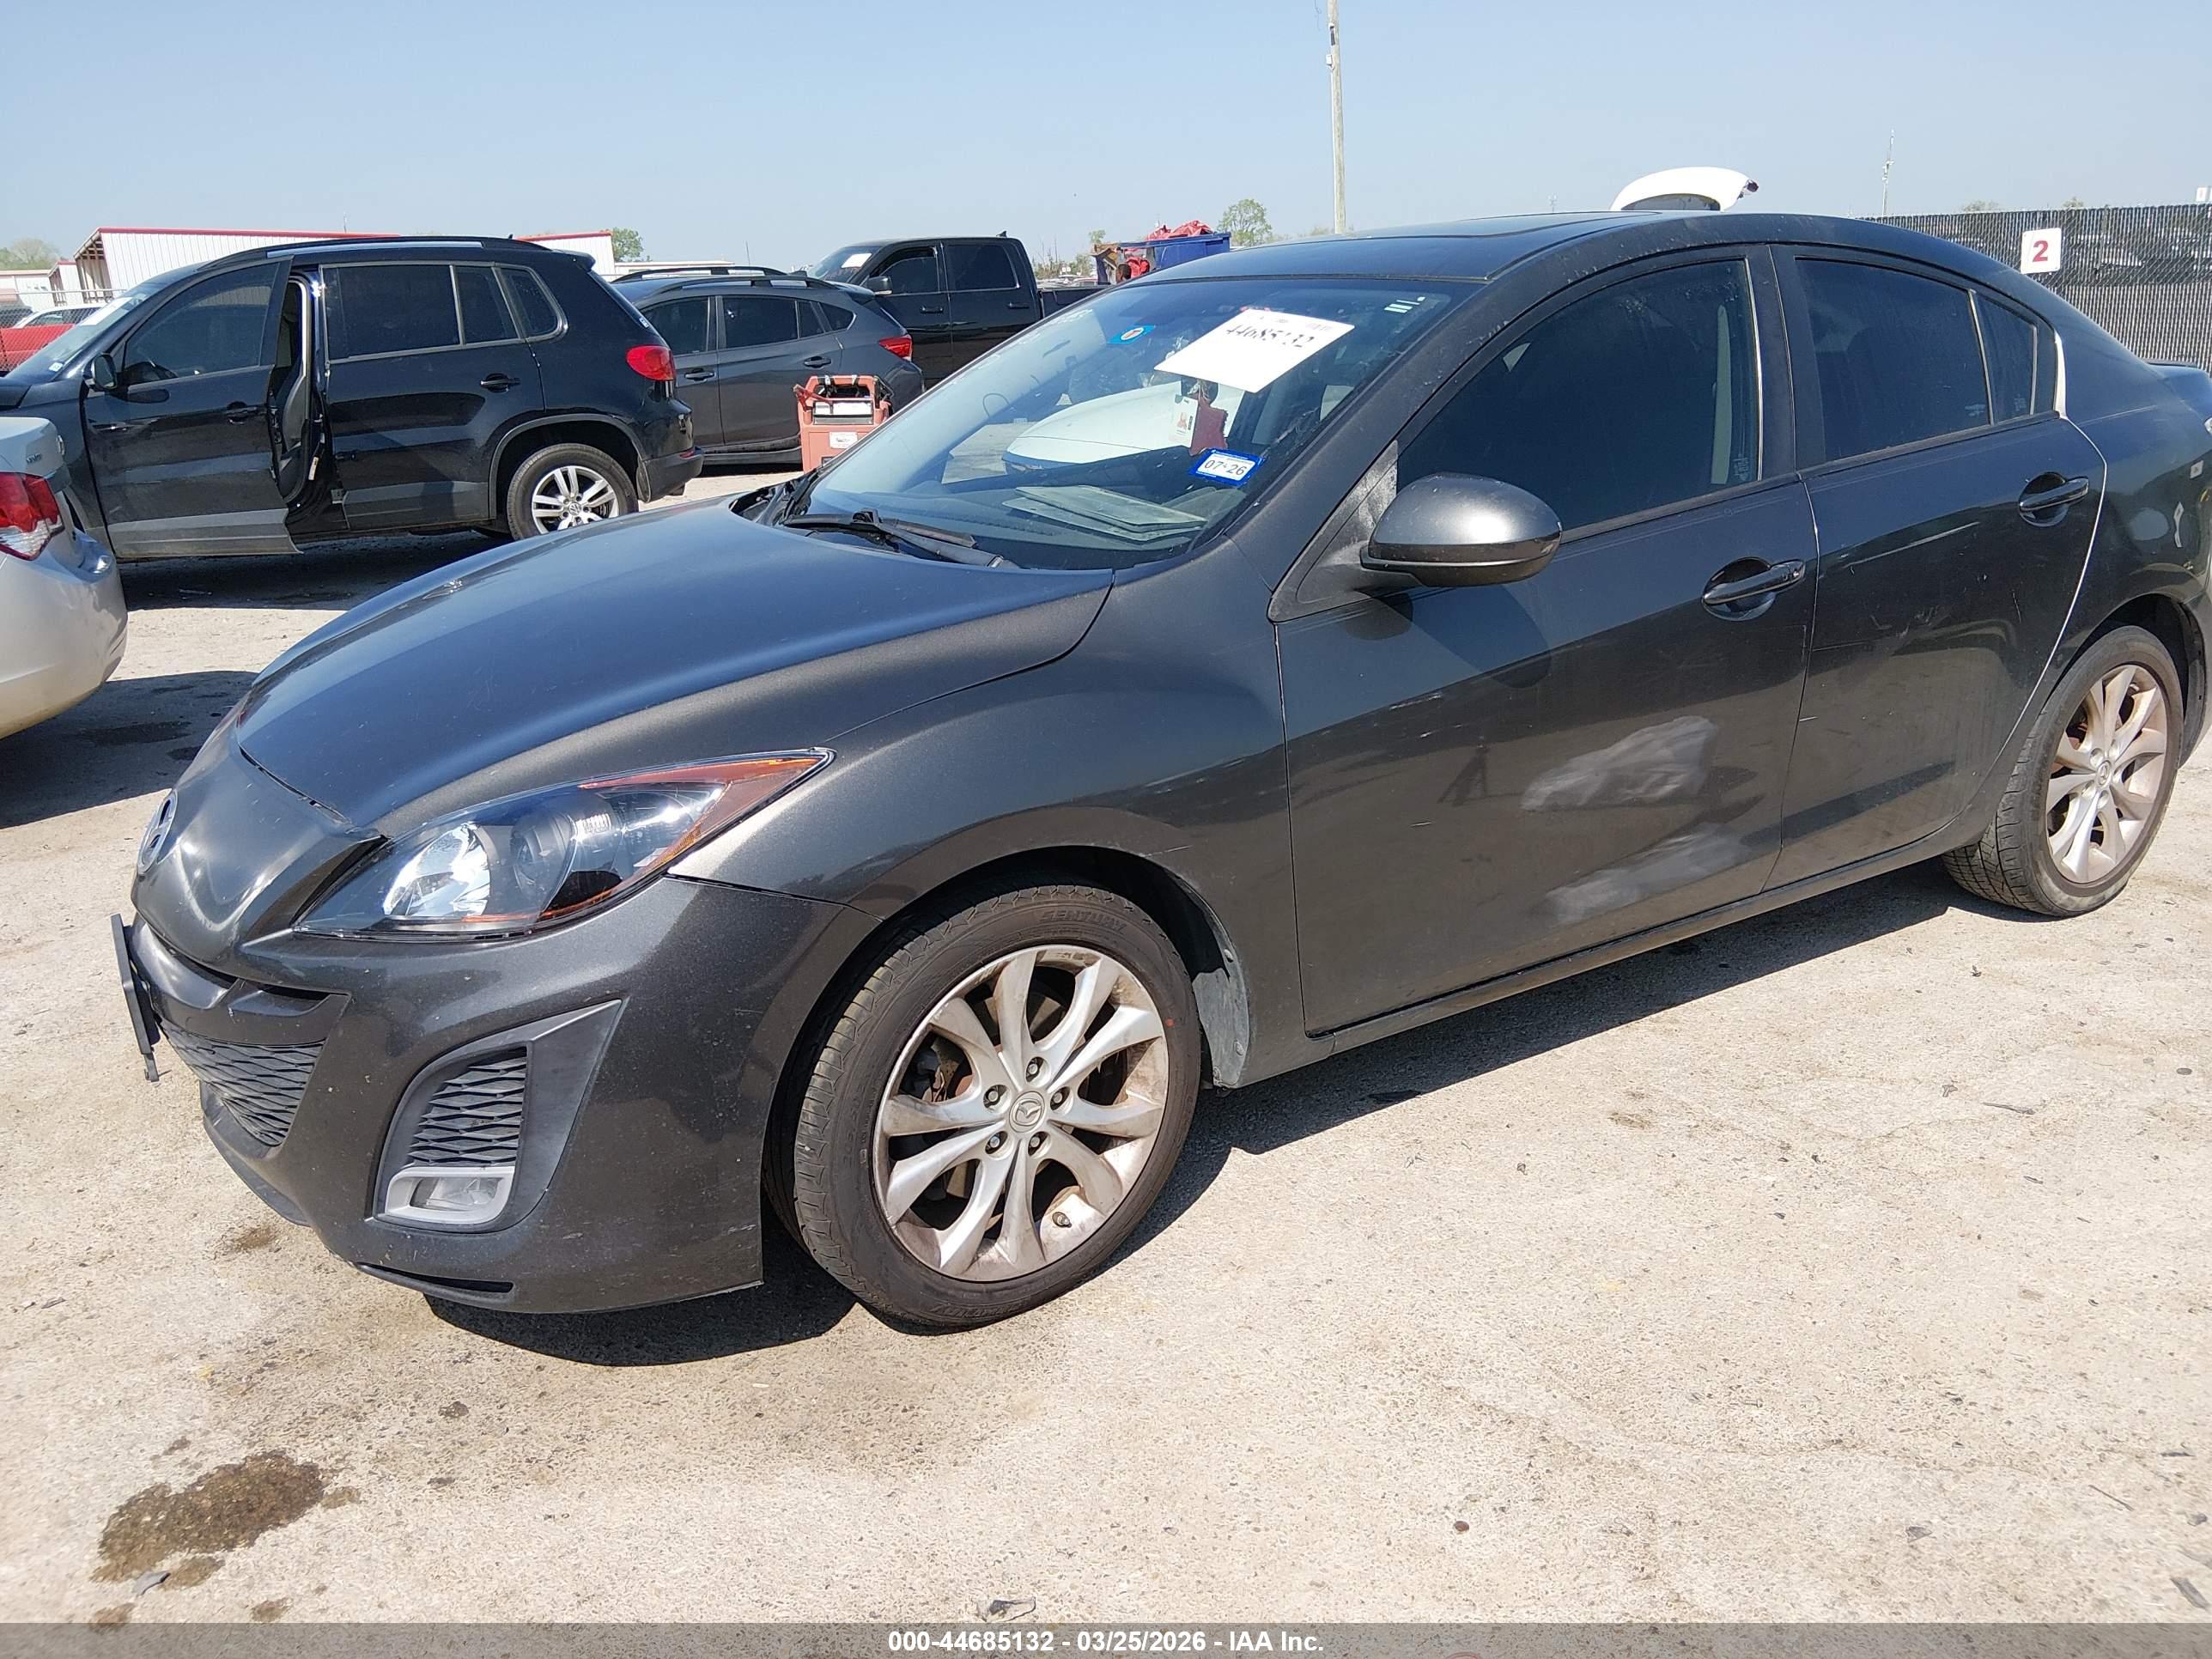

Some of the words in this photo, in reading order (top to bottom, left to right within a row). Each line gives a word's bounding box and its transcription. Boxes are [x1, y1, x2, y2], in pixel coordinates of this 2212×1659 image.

[2033, 240, 2049, 262] 2
[1204, 459, 1225, 471] 07
[1225, 464, 1248, 476] 26
